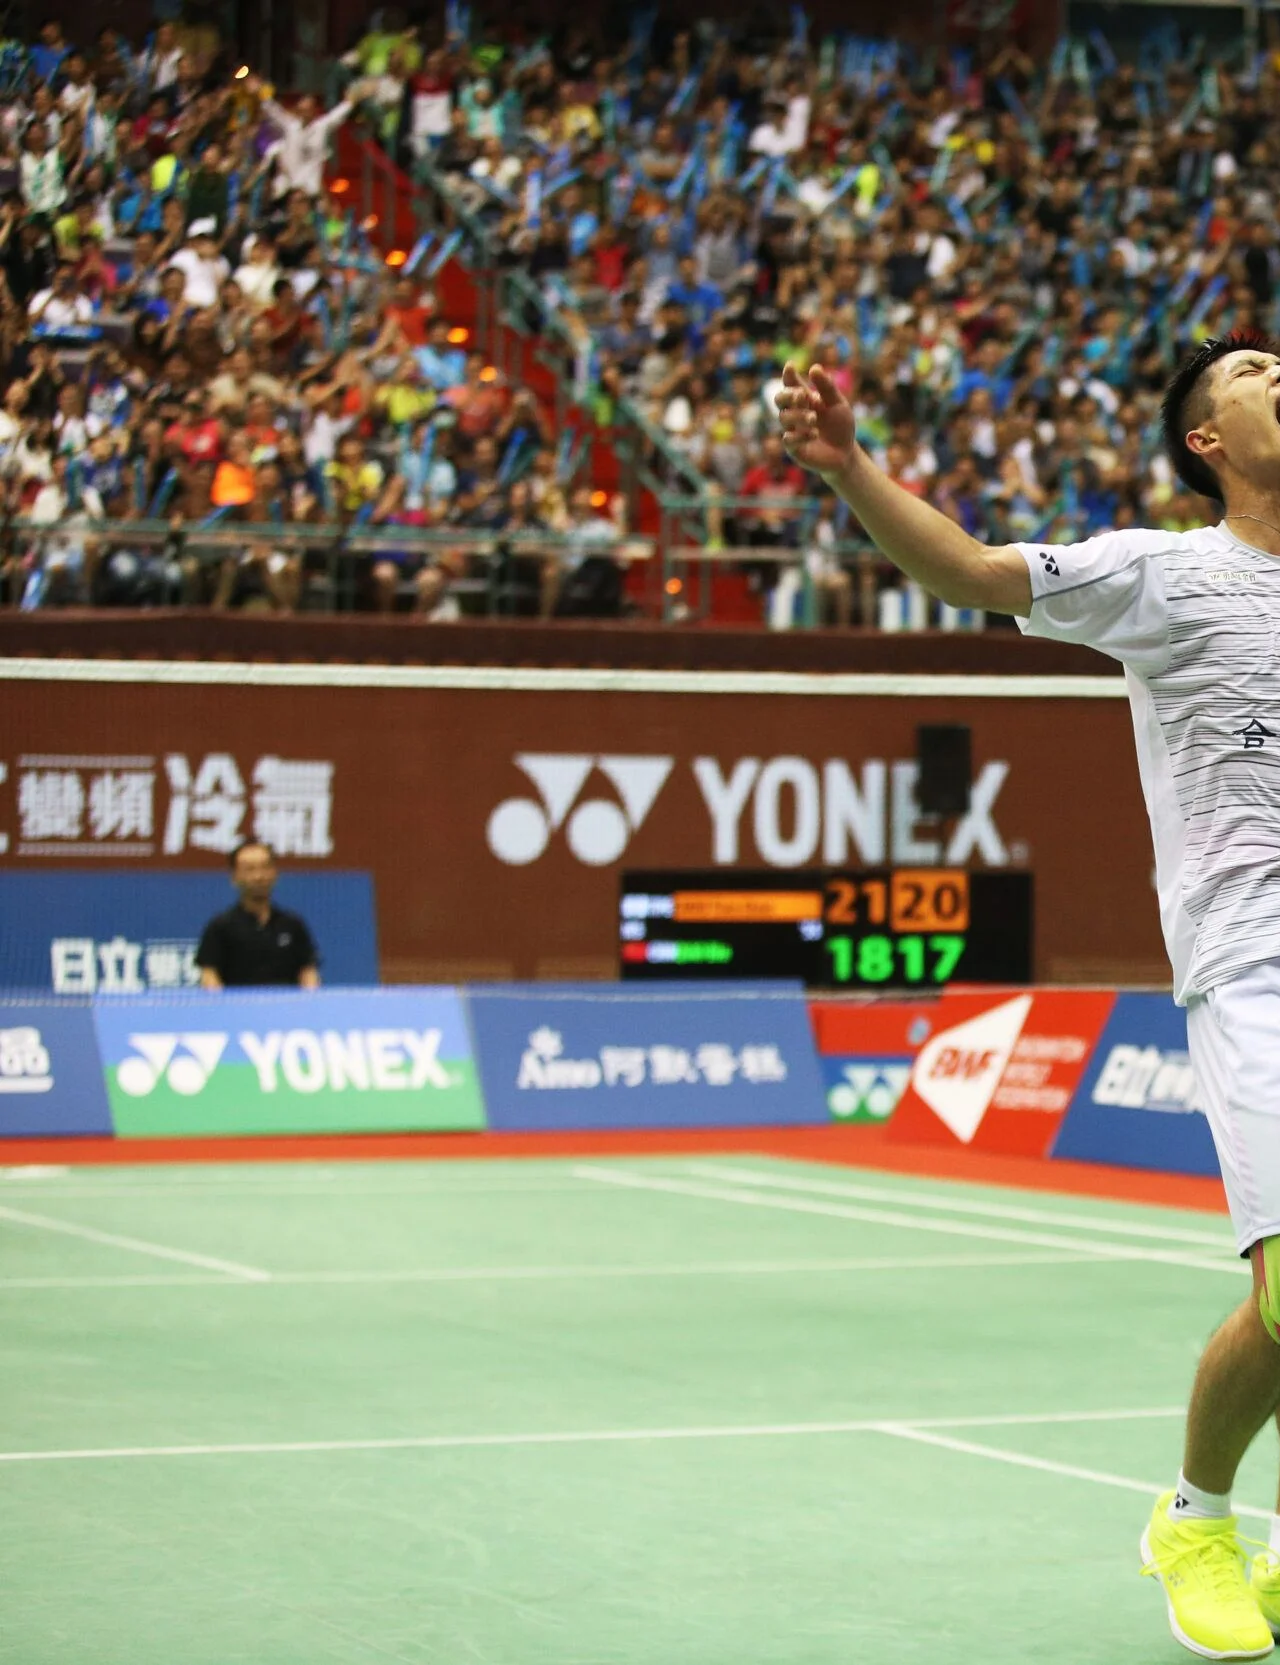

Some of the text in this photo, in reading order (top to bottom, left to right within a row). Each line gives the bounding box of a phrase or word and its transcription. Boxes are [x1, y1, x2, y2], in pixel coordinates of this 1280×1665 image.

[0, 752, 335, 857] 變頻冷氣
[692, 755, 1009, 867] YONEX
[825, 880, 888, 924] 21
[899, 880, 964, 923] 20
[826, 935, 965, 982] 18 17
[238, 1026, 451, 1094] YONEX
